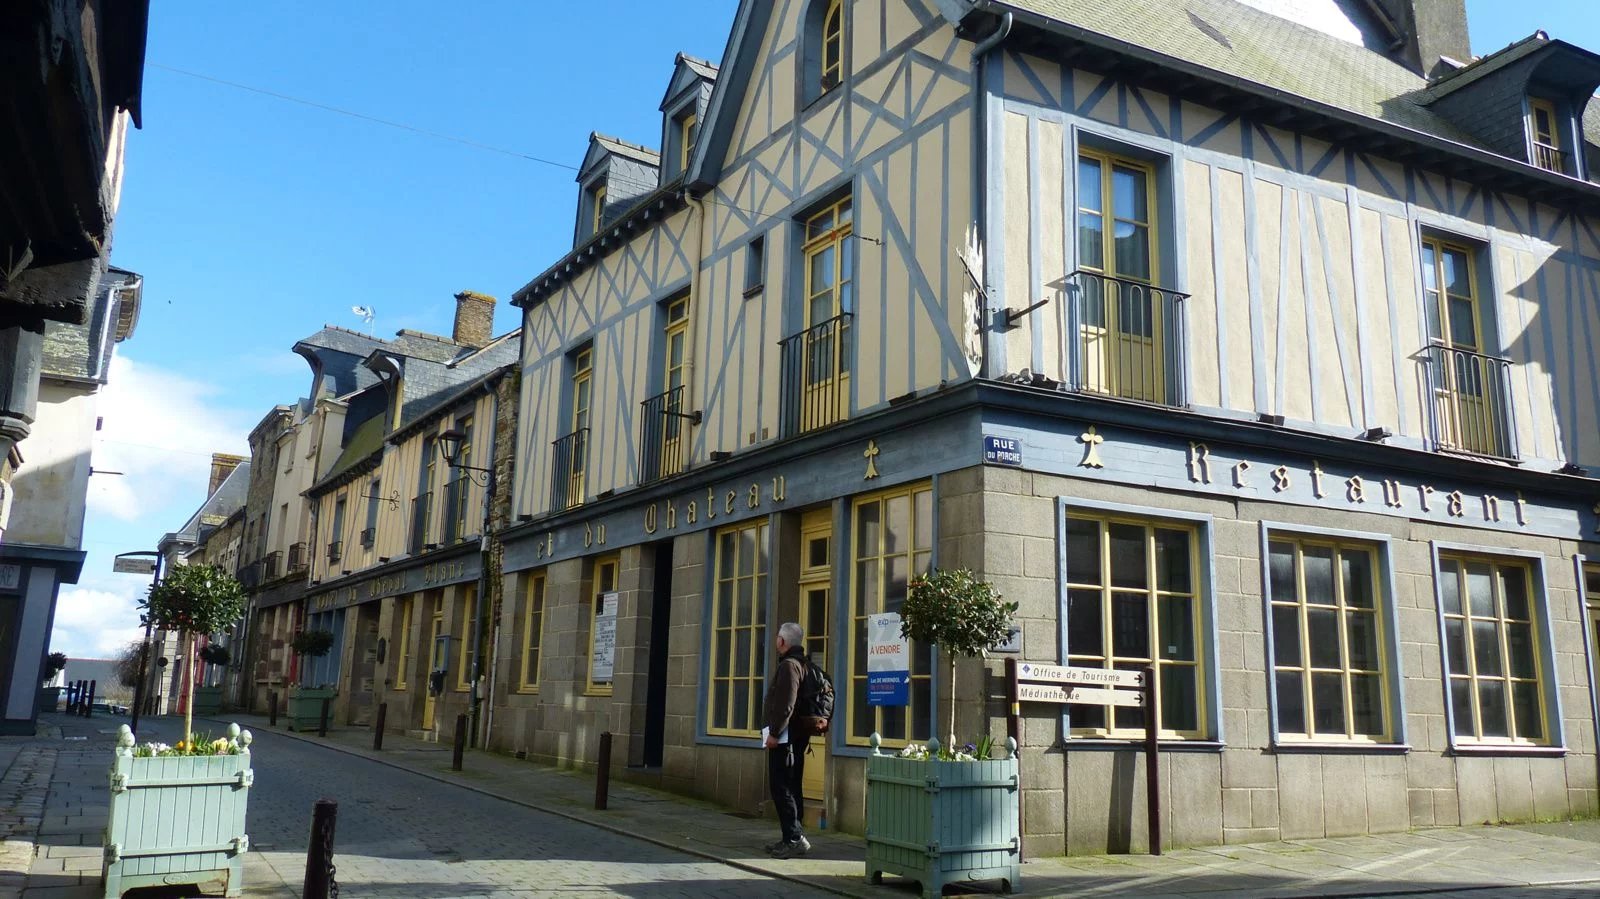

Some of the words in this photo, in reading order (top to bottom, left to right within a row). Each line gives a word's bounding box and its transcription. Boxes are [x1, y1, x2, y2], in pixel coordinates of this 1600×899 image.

[993, 439, 1015, 450] RUE
[987, 451, 996, 459] DU
[997, 450, 1021, 462] PORCHE
[1185, 441, 1531, 527] Restaurant
[536, 532, 553, 560] et
[584, 521, 606, 549] du
[644, 475, 786, 534] Chateau
[424, 561, 465, 585] Blanc
[875, 644, 901, 655] VENDRE
[1033, 667, 1061, 679] Office
[1066, 670, 1077, 679] de
[1082, 671, 1120, 682] Tourisme
